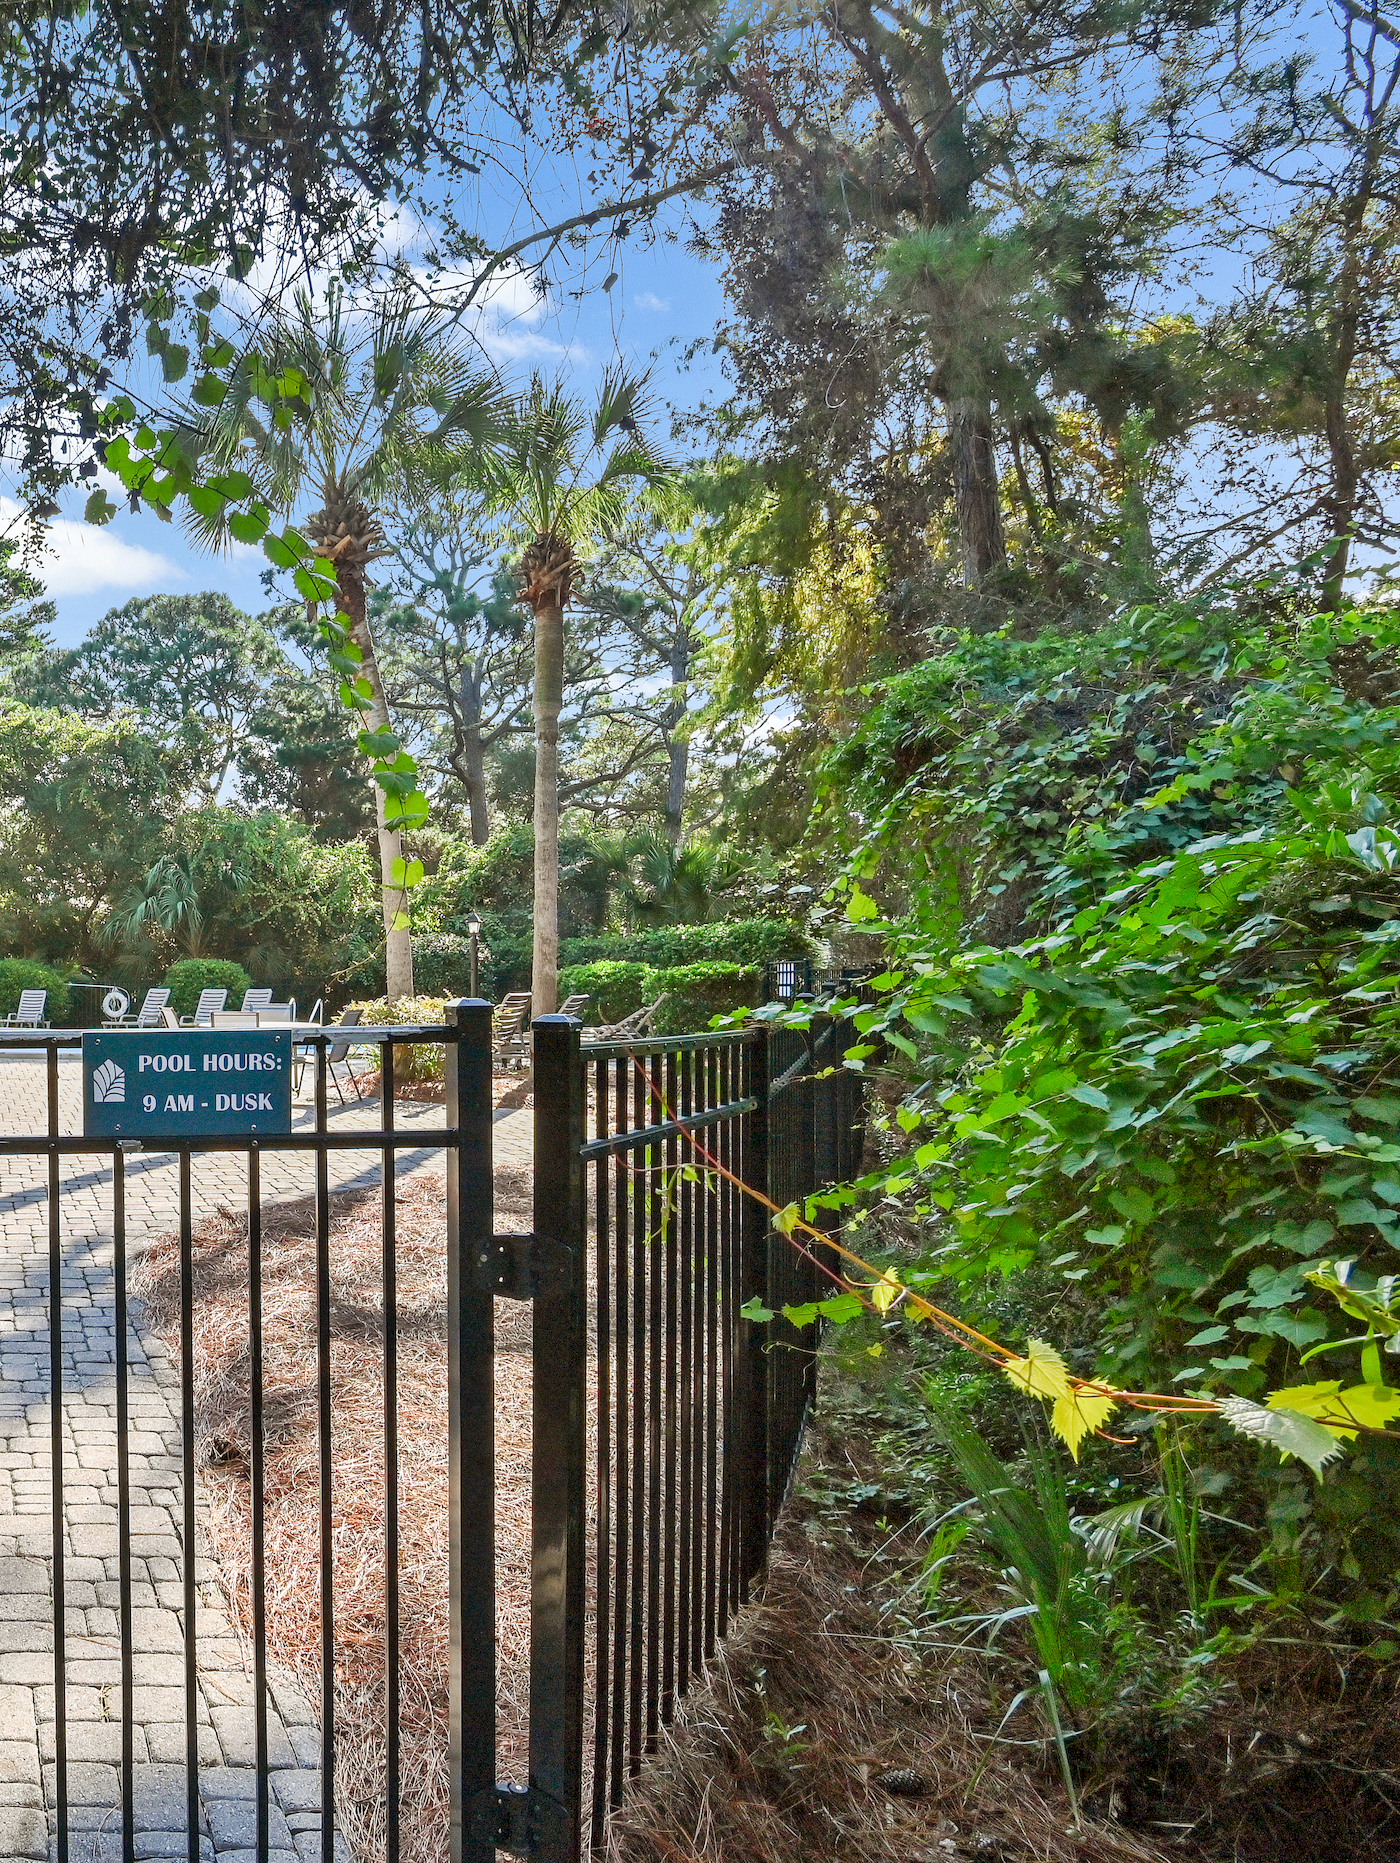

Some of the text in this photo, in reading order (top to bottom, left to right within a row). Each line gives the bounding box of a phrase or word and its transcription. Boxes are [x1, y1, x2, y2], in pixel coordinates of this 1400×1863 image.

[138, 1052, 282, 1073] POOL HOURS:
[142, 1094, 157, 1113] 9
[163, 1094, 195, 1112] AM
[215, 1092, 274, 1112] DUSK
